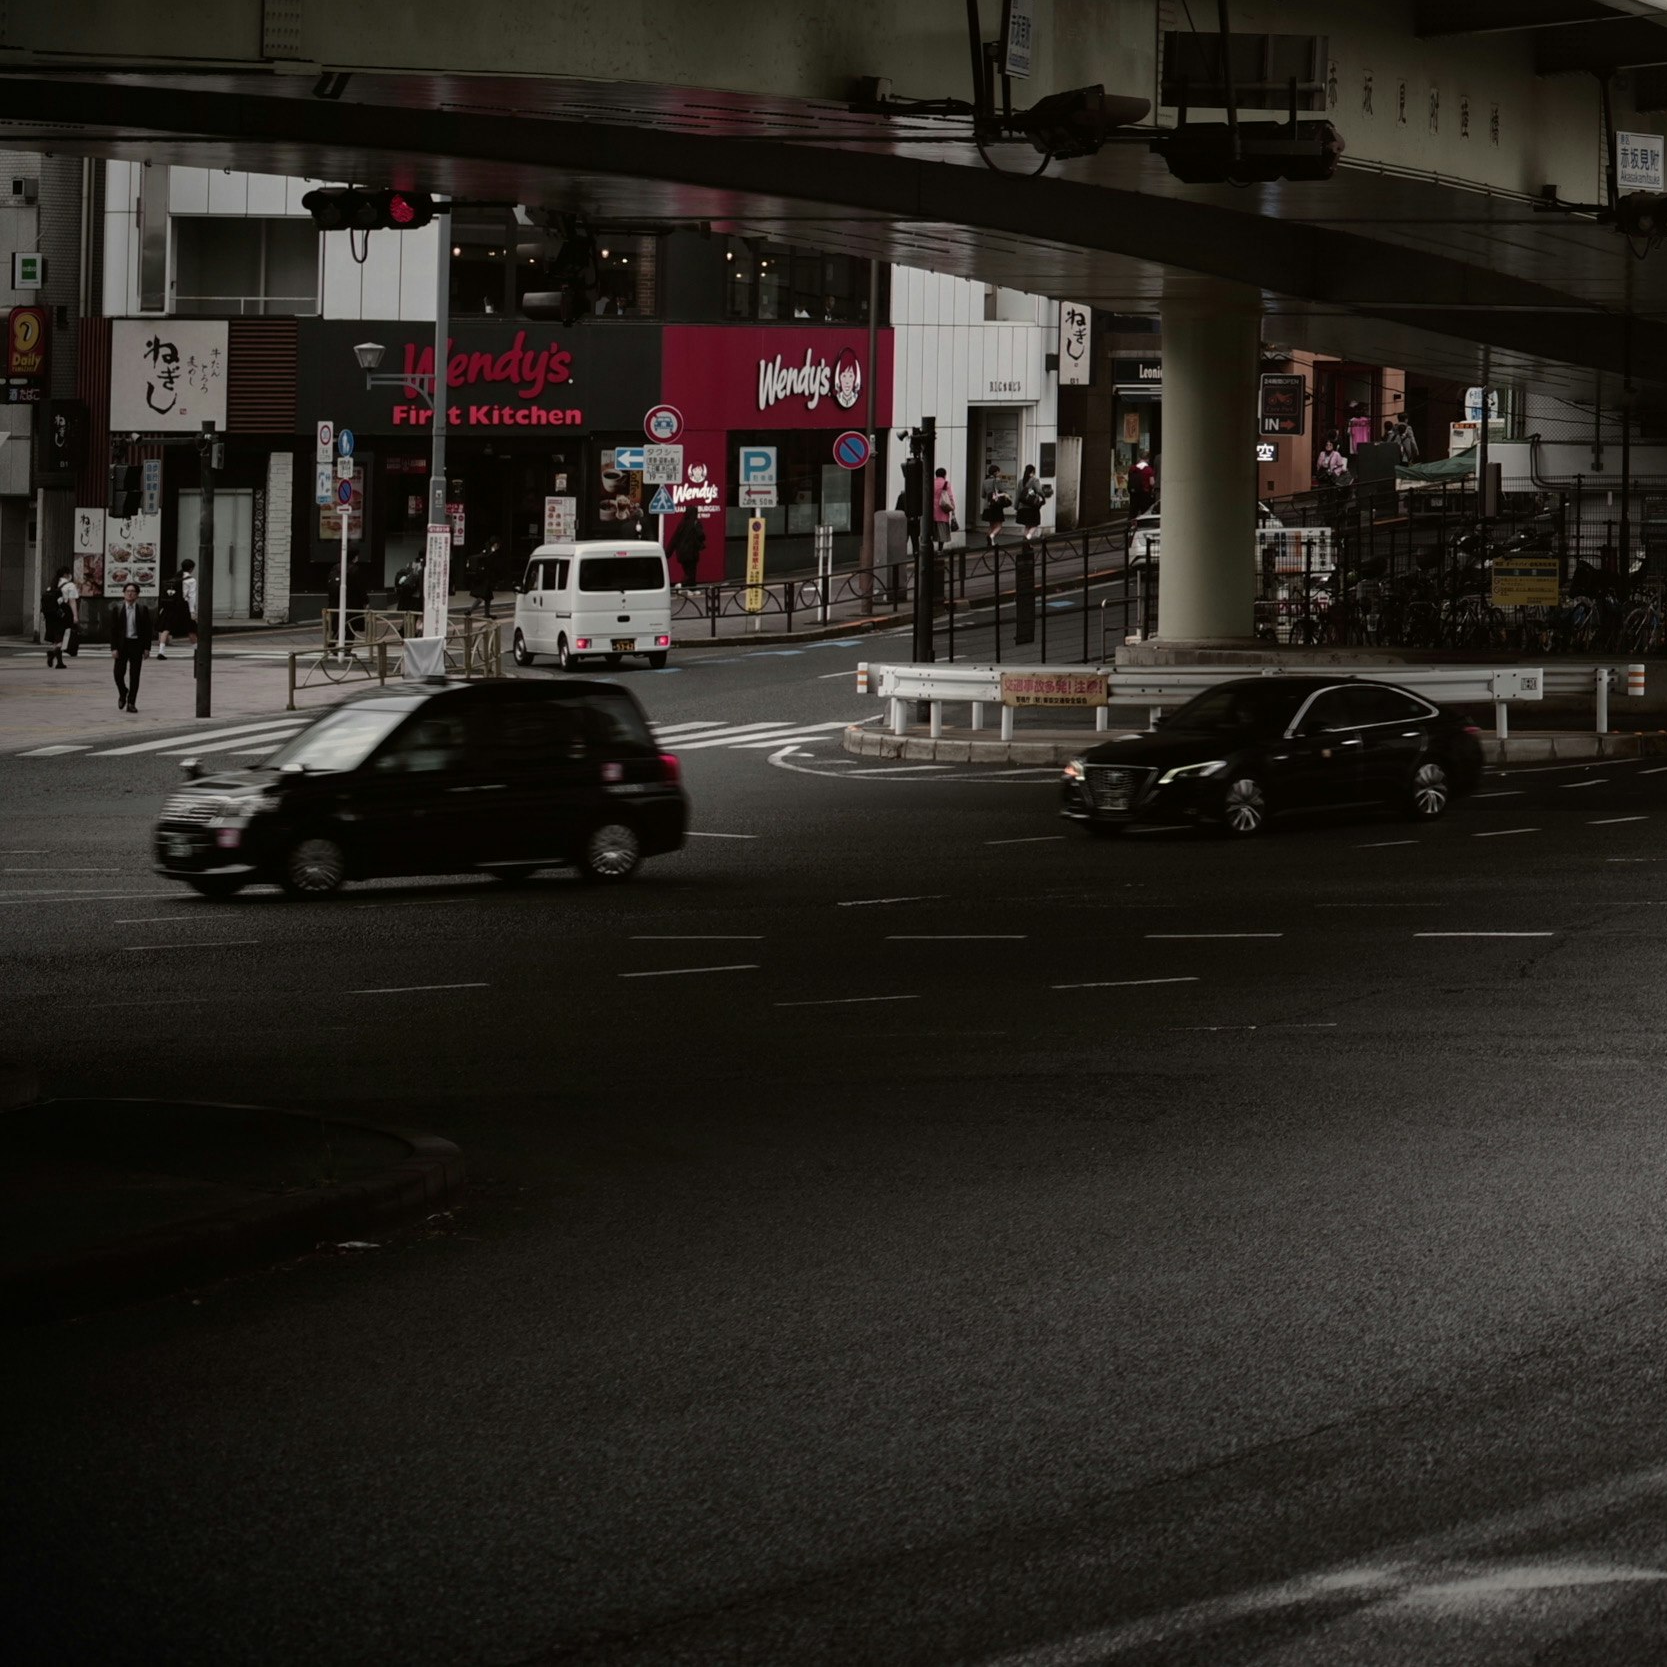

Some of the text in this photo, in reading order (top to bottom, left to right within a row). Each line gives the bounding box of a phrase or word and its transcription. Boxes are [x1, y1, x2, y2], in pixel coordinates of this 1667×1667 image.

[1620, 146, 1660, 171] 赤坂見附
[1065, 309, 1087, 361] ねぎし
[12, 353, 43, 373] Daily
[144, 334, 180, 415] ねぎし
[403, 329, 574, 400] Wendy's
[758, 347, 832, 411] Wendy's
[392, 404, 583, 426] Firt Kitchen
[1264, 418, 1280, 431] IN
[647, 448, 680, 456] タクシー
[1256, 443, 1274, 462] 空
[743, 451, 772, 482] P
[672, 481, 718, 504] Wendy's
